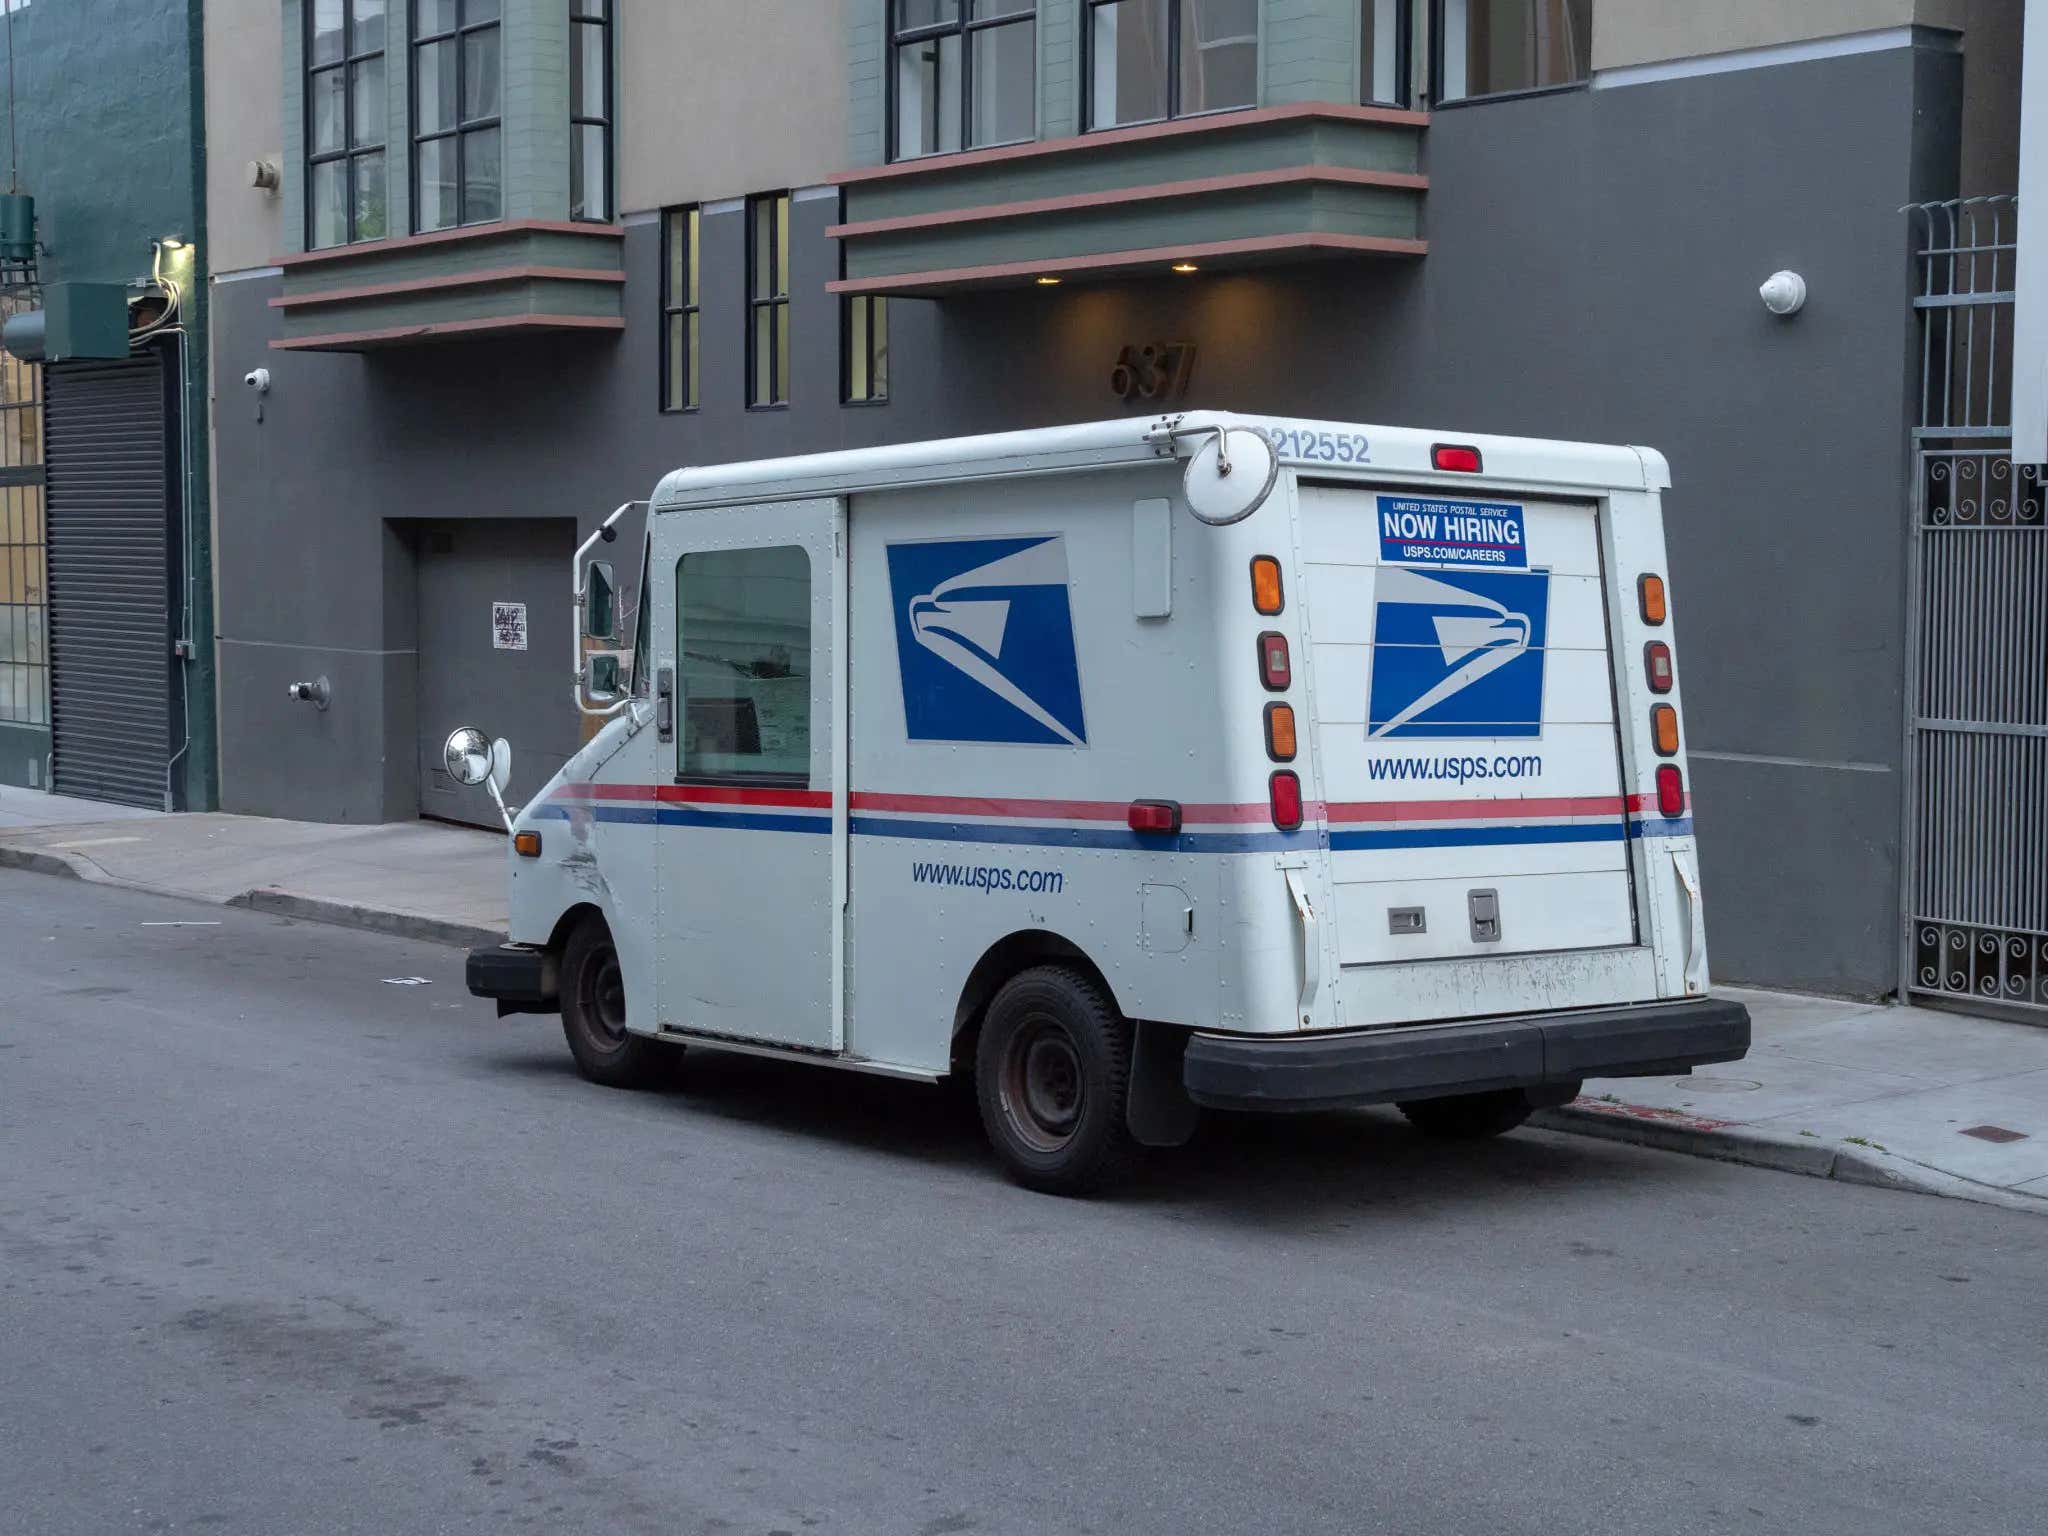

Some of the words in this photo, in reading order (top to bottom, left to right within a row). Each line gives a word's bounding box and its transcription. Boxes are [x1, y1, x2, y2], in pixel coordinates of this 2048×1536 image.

[1111, 342, 1199, 399] 637
[1392, 501, 1420, 512] UNITED
[1421, 503, 1448, 514] STATES
[1450, 505, 1477, 516] POSTAL
[1480, 508, 1508, 518] SERVICE
[1383, 512, 1438, 540] NOW
[1444, 516, 1520, 545] HIRING
[1403, 545, 1506, 562] USPS.COM/CAREERS
[1368, 755, 1542, 785] www.usps.com
[912, 862, 1063, 895] www.usps.com
